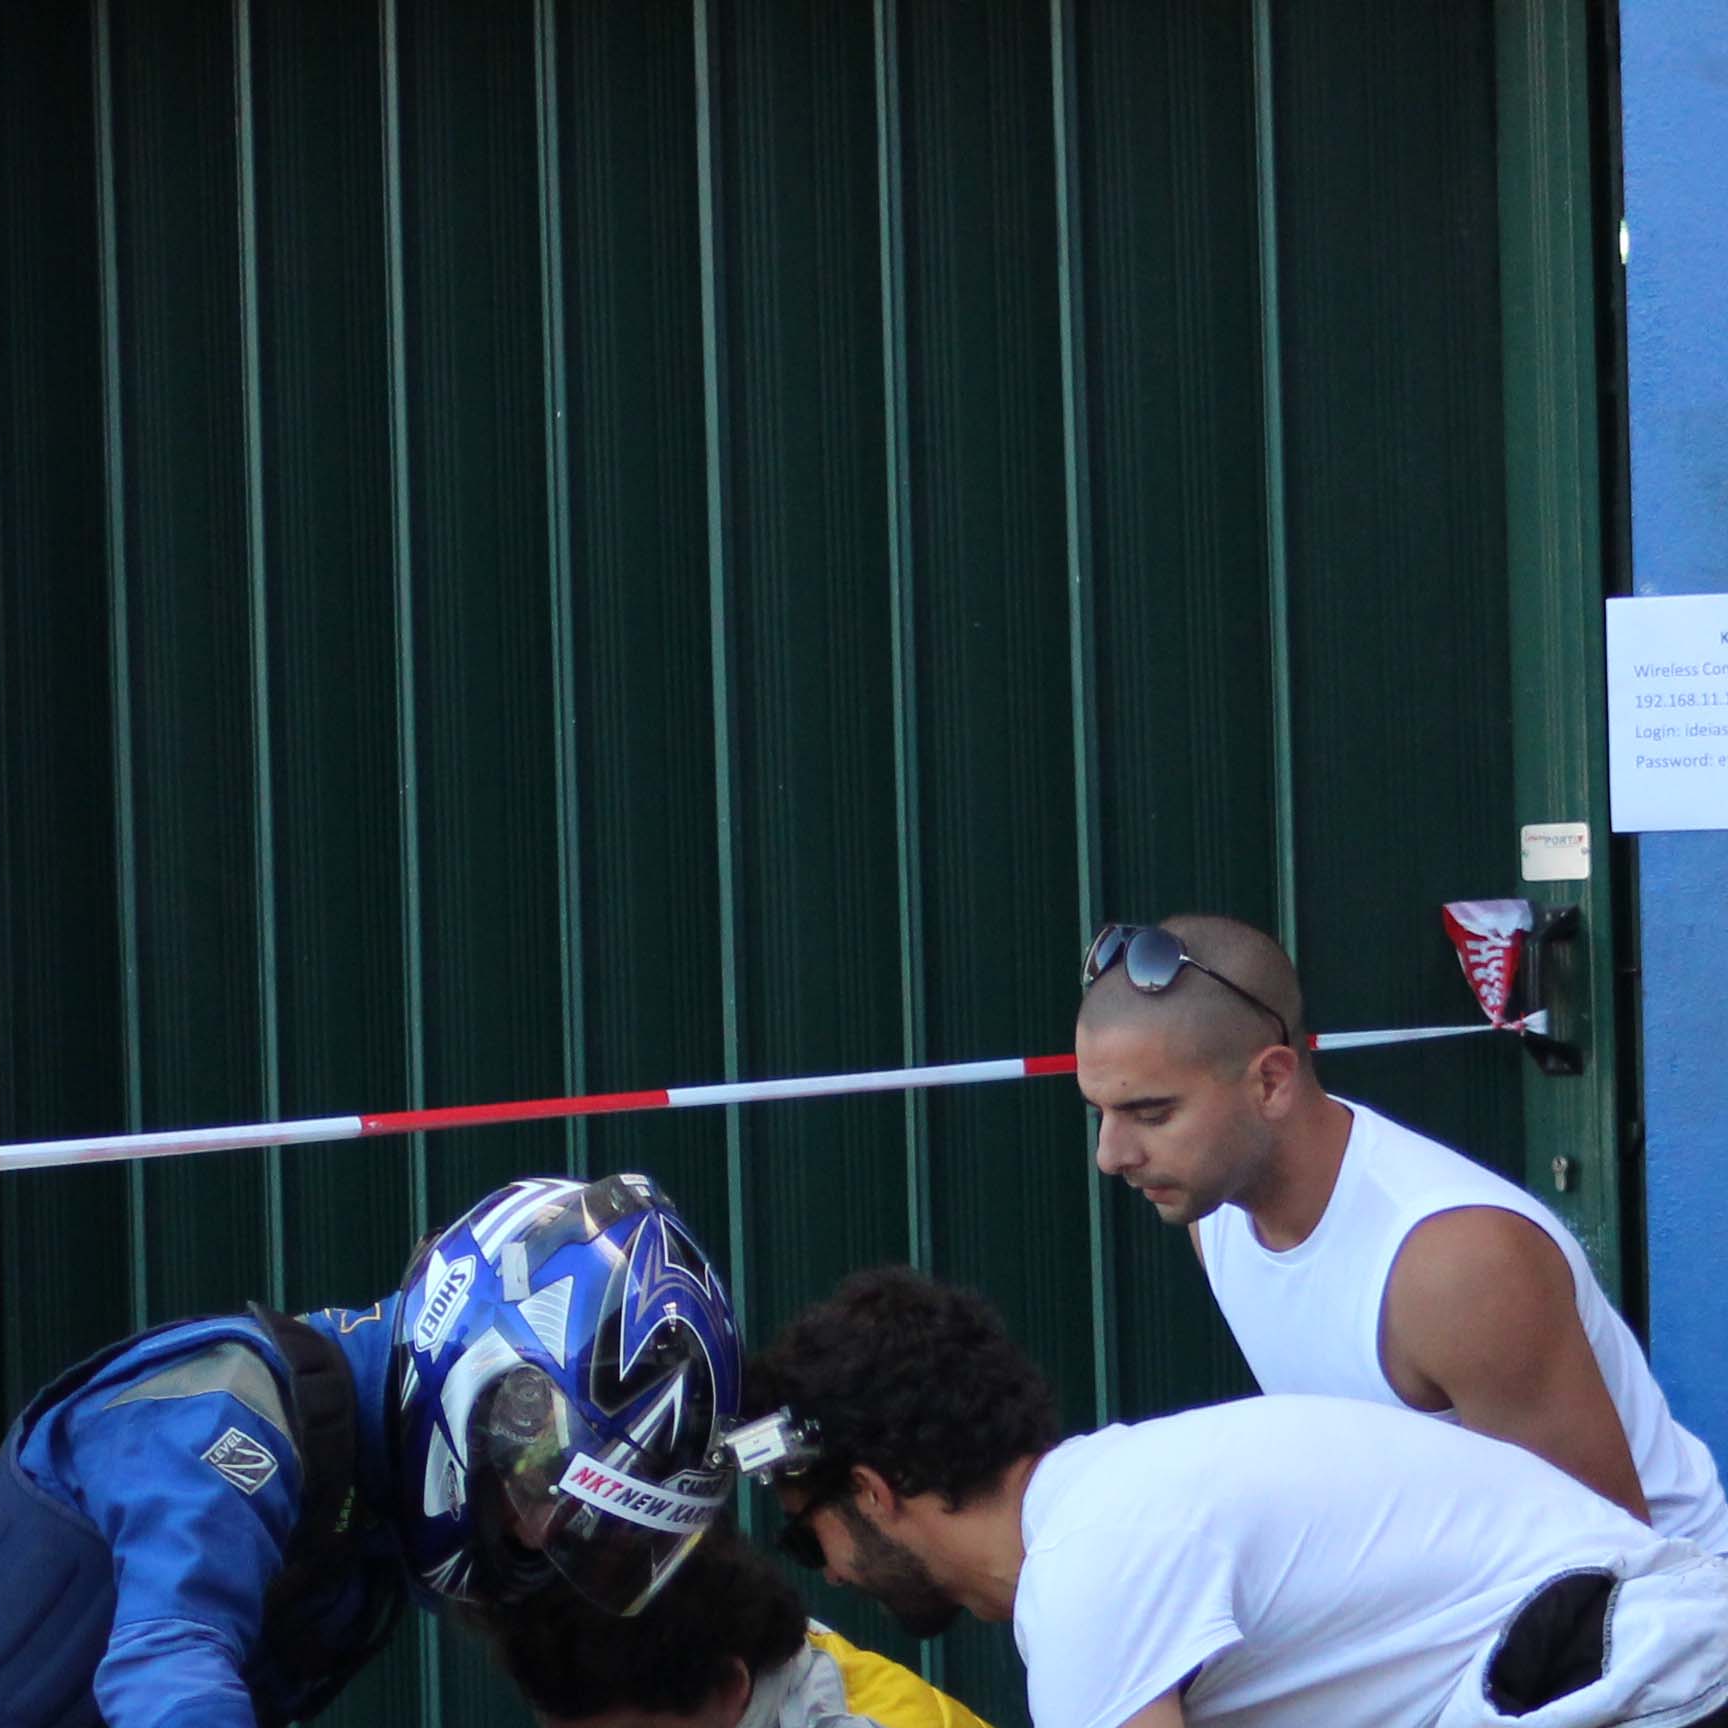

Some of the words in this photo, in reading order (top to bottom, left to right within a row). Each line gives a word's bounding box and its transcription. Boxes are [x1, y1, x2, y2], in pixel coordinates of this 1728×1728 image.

[1633, 663, 1699, 679] Wireless
[1635, 724, 1681, 741] Login:
[1635, 752, 1713, 770] Password:
[419, 1266, 467, 1340] SHOEI
[208, 1433, 243, 1464] LEVEL
